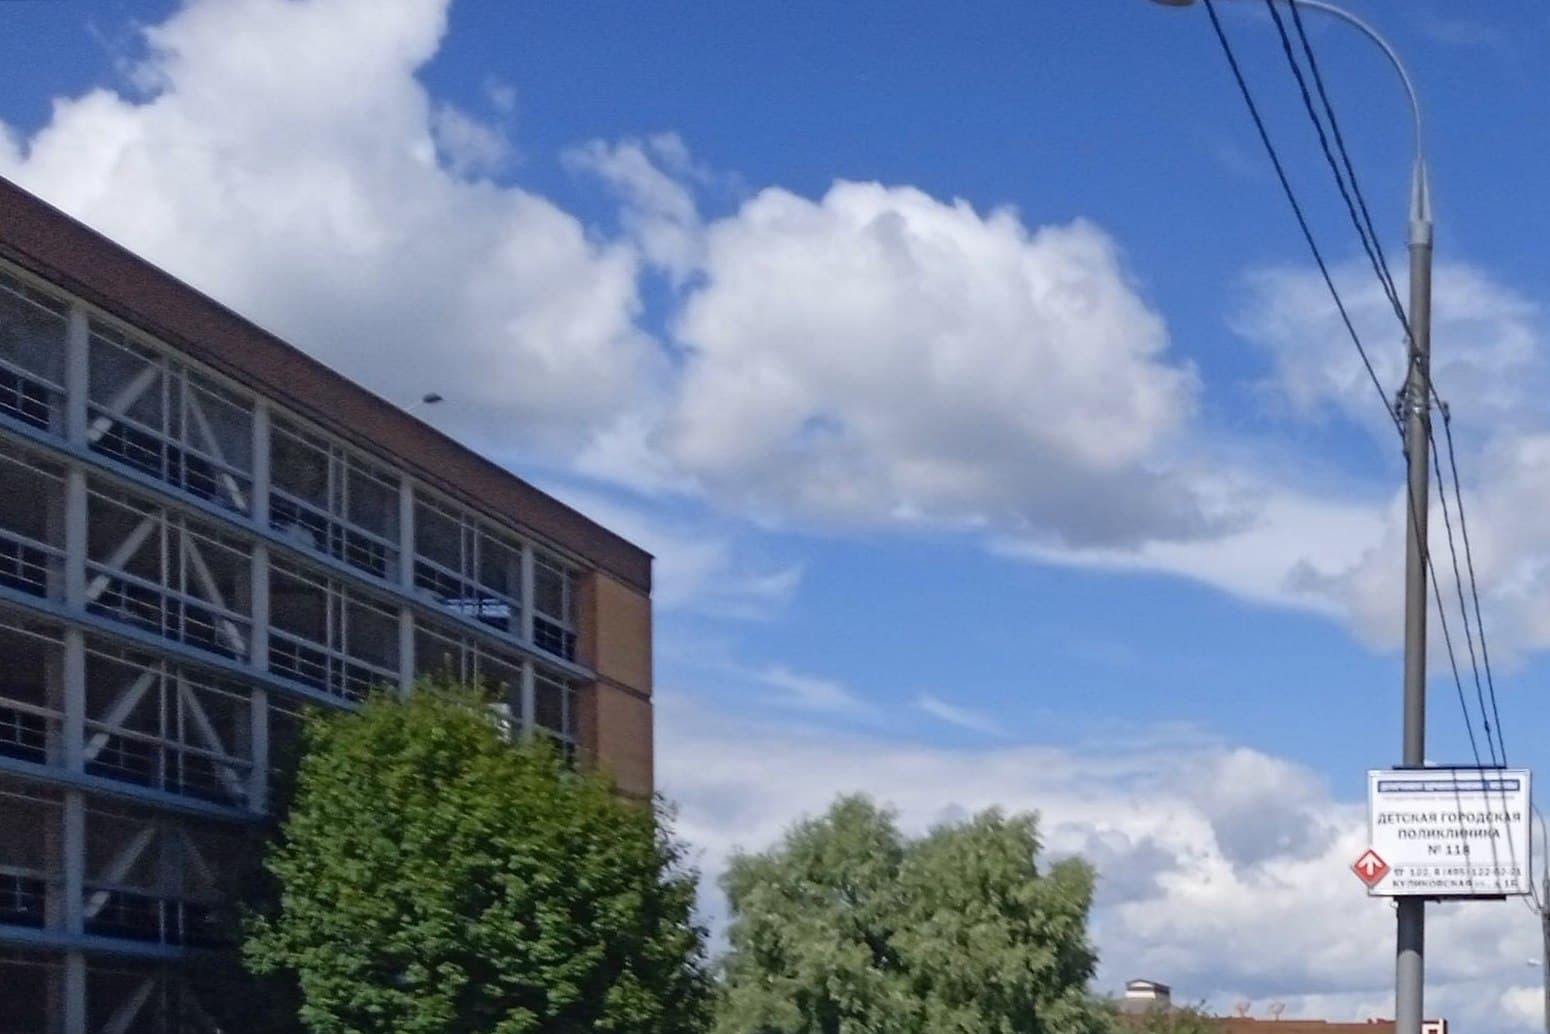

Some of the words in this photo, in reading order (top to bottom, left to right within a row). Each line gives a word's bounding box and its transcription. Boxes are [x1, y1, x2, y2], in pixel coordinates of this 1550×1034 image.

[1377, 813, 1436, 825] ДЕТСКАЯ
[1440, 812, 1521, 825] ГОРОДСКАЯ
[1397, 829, 1500, 840] ПОЛИКЛИНИКА
